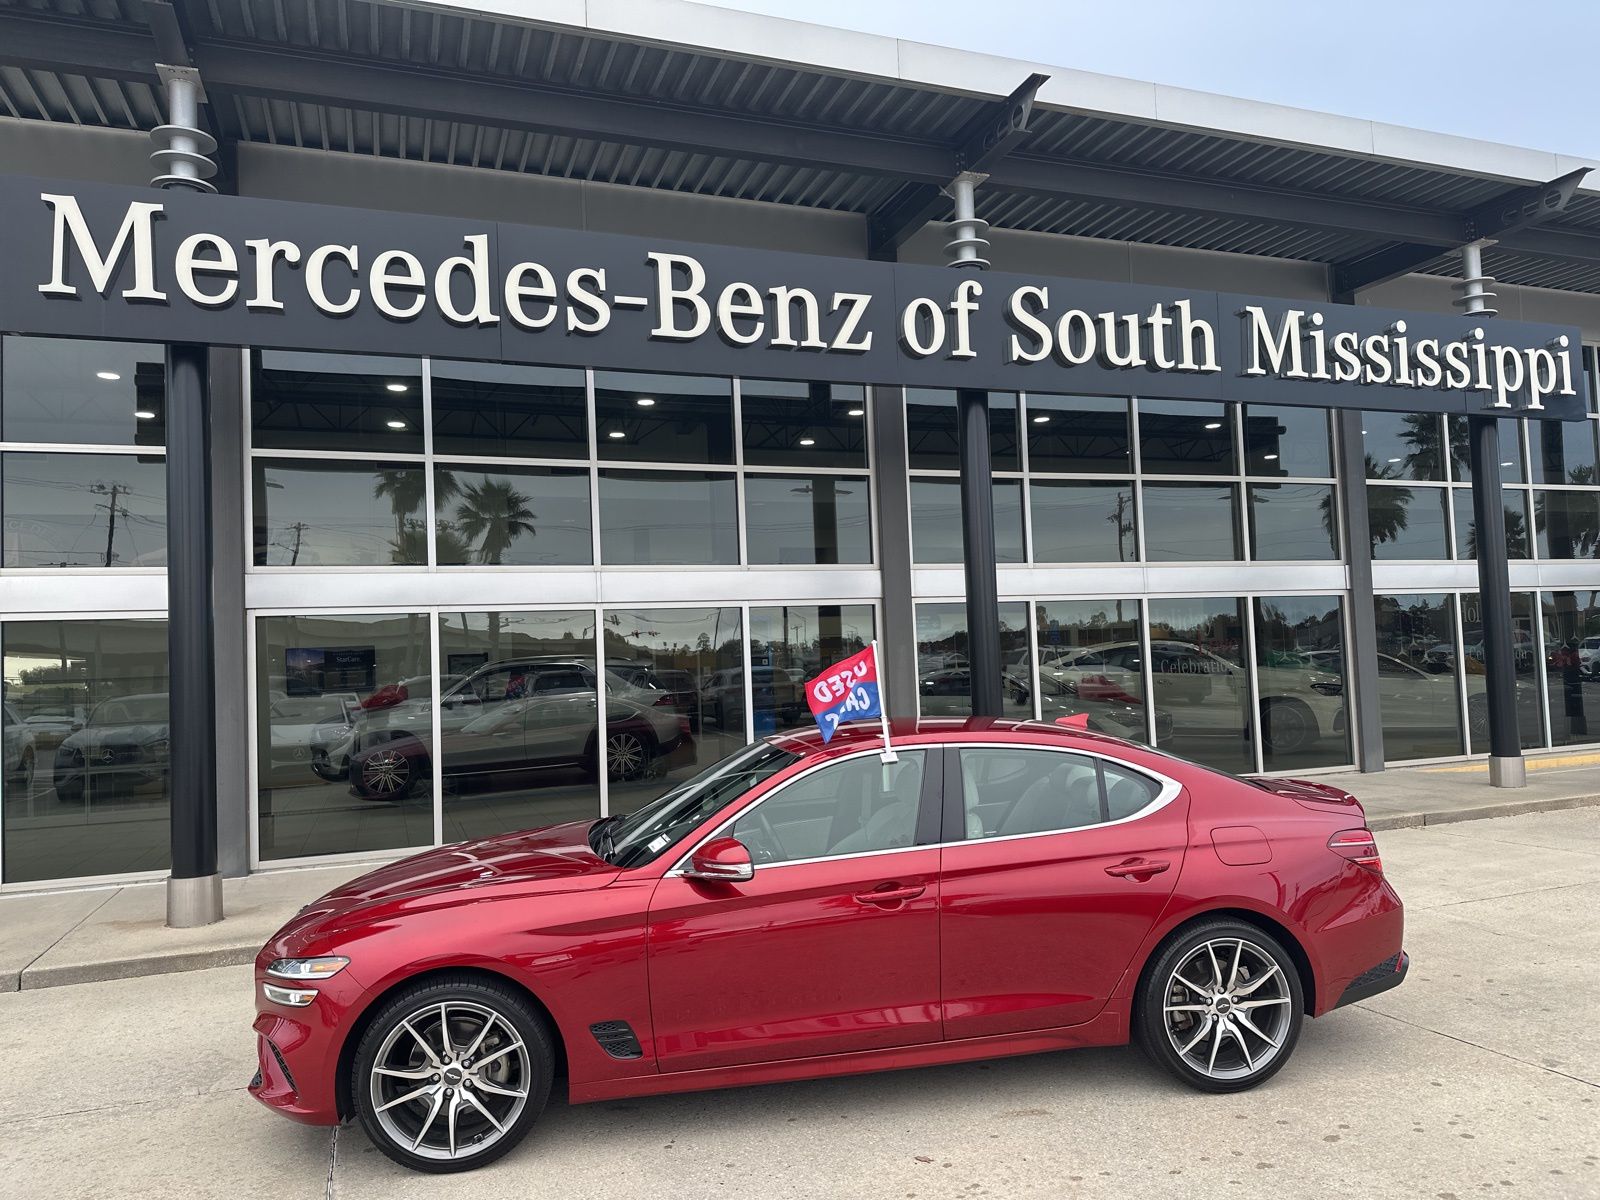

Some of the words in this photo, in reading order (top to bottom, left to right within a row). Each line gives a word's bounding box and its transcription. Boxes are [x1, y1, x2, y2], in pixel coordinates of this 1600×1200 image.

[38, 193, 873, 351] Mercedes-Benz
[903, 280, 983, 357] of
[1011, 286, 1222, 372] South
[1246, 306, 1577, 410] Mississippi
